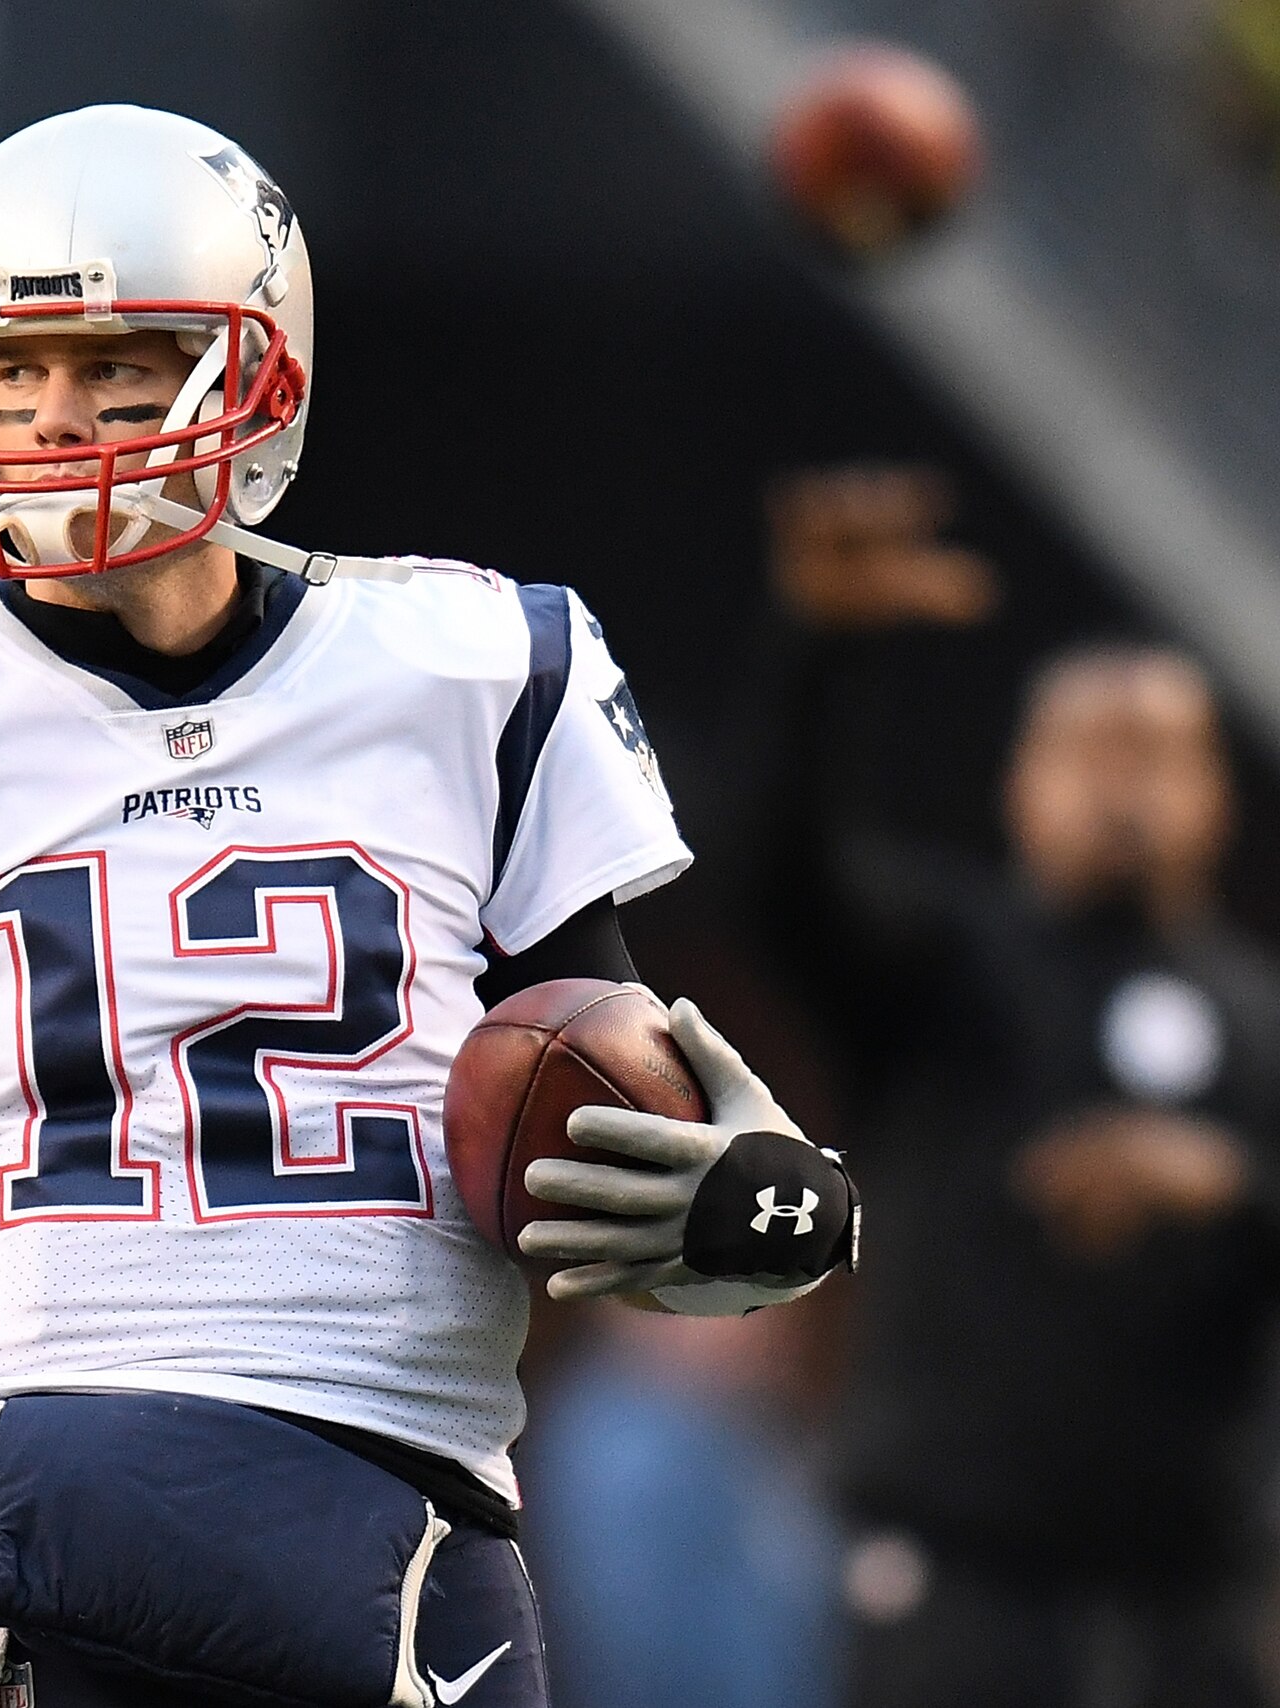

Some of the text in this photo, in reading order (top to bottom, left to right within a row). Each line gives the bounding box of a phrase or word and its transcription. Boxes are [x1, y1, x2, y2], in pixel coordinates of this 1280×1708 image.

[10, 271, 83, 301] PATRIOTS
[172, 733, 209, 756] NFL
[122, 786, 262, 824] PATRIOTS
